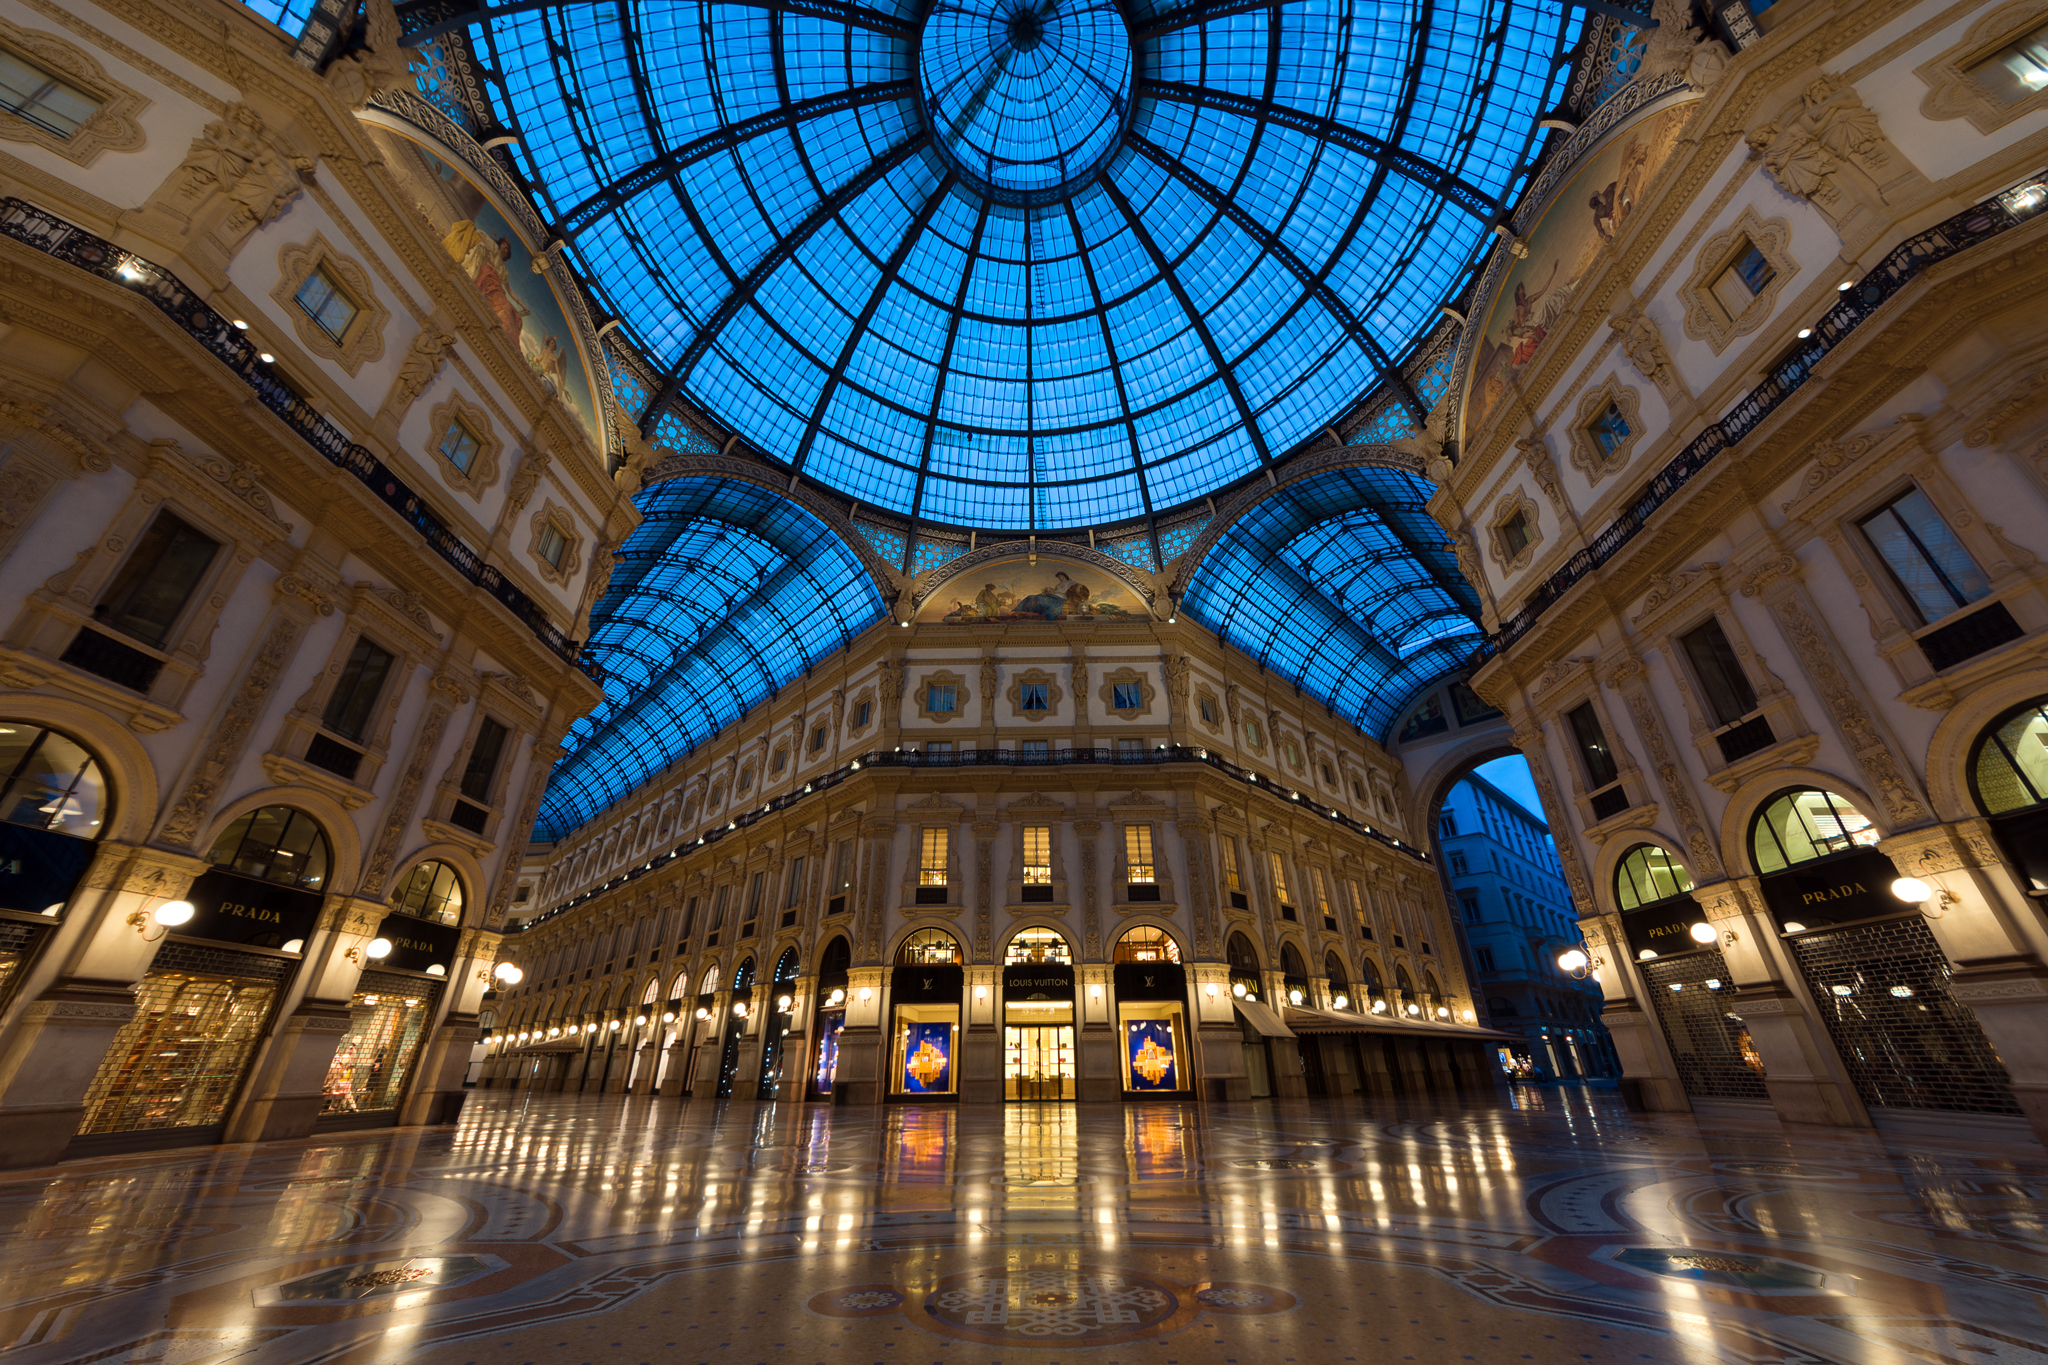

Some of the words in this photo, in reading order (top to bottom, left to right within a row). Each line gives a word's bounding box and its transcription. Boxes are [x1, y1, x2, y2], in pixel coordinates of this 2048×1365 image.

[1802, 882, 1868, 905] PRADA
[219, 901, 280, 923] PRADA
[1648, 922, 1689, 938] PRADA
[395, 936, 433, 953] PRADA
[1009, 979, 1033, 987] LOUIS
[1033, 979, 1068, 987] VUITTON
